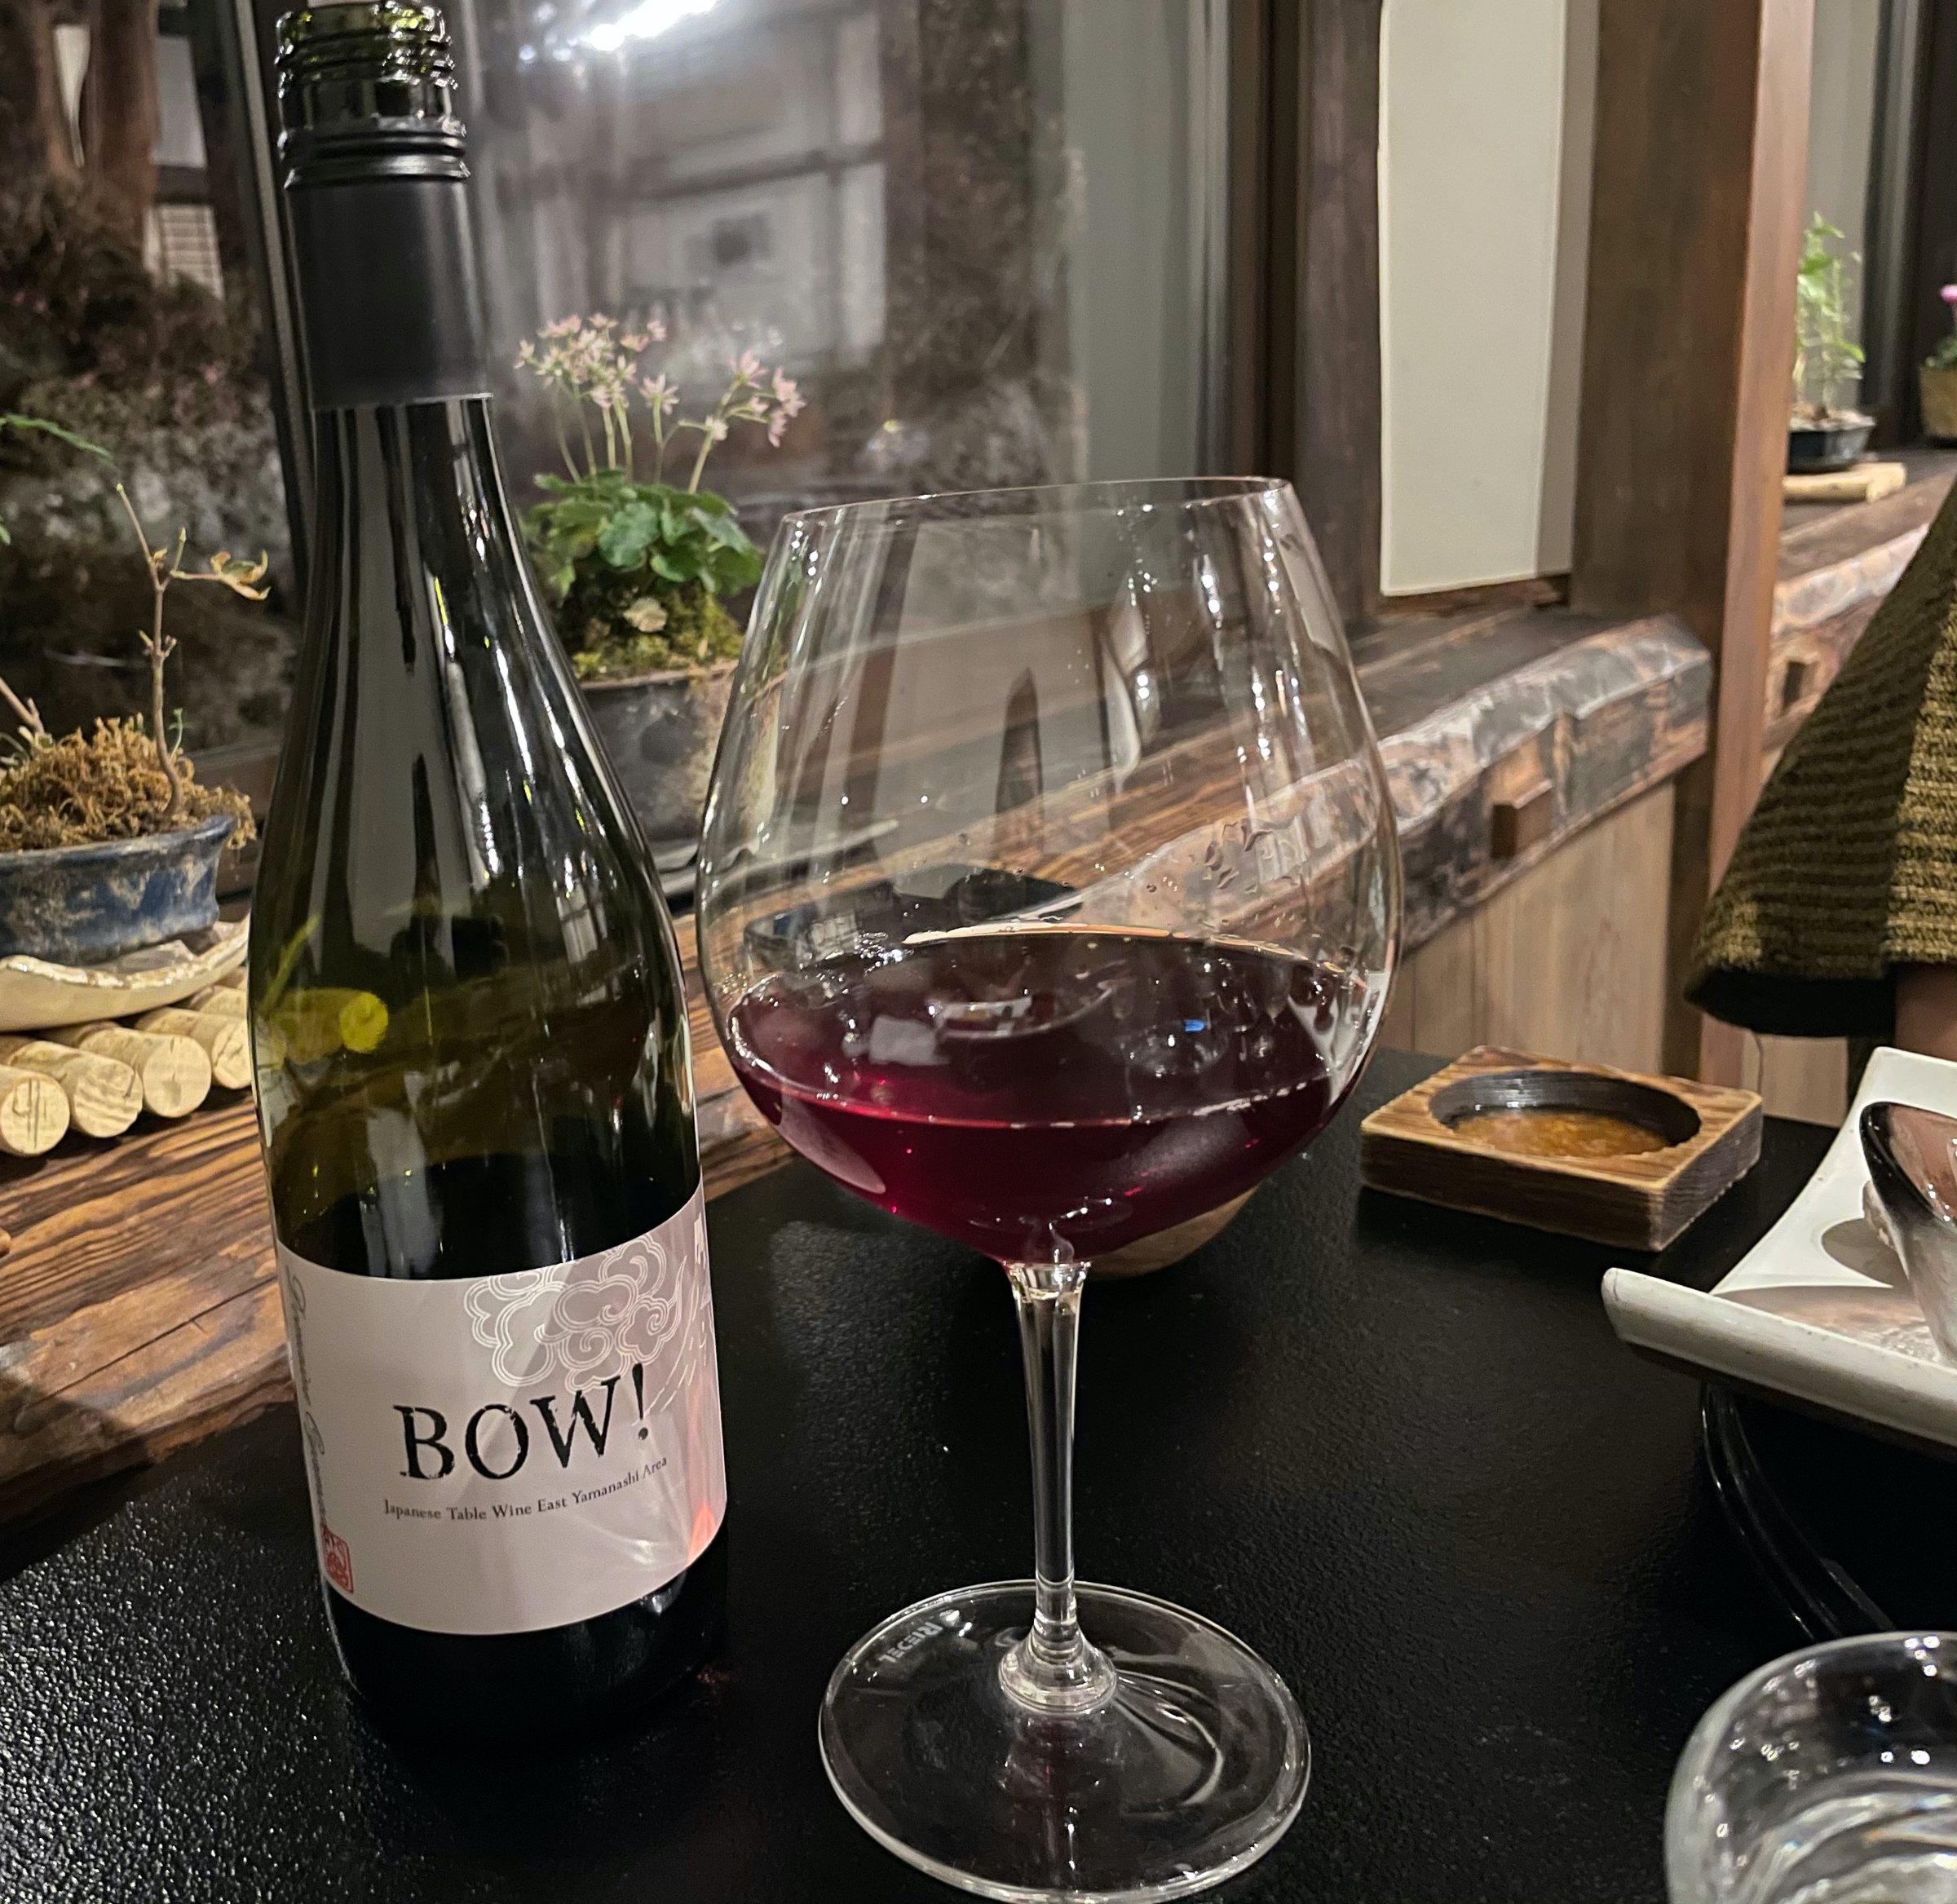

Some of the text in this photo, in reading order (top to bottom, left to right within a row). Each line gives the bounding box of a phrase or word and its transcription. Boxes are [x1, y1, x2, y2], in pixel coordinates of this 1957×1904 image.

[392, 1363, 649, 1481] BOW!
[383, 1457, 668, 1521] Japanese Table Wine East Yamanashi Area
[877, 1621, 943, 1663] RIEDEL
